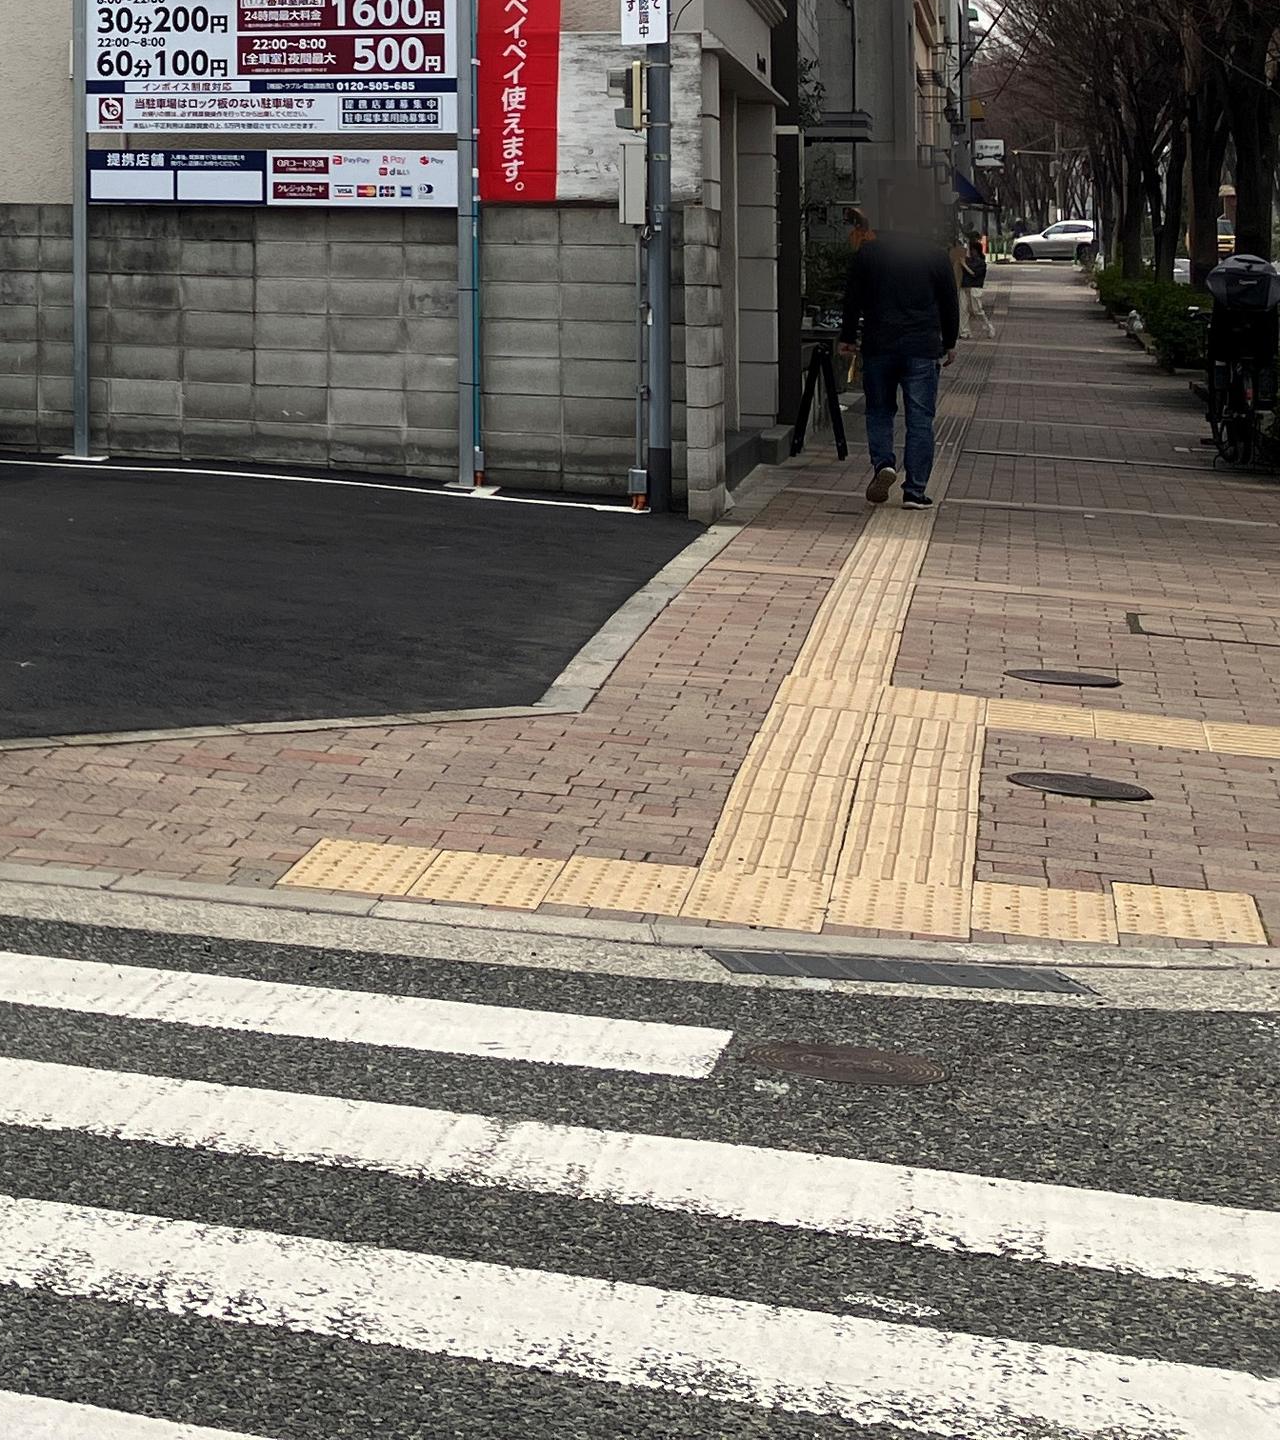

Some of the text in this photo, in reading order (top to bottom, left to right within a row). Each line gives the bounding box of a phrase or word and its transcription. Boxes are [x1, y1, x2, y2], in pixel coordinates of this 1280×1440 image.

[244, 9, 323, 22] 24時間最大料金
[352, 37, 441, 72] 500円
[142, 82, 233, 92] インボイス制度対応
[336, 81, 416, 92] 0120-505-685
[134, 97, 316, 110] 当駐車場はロック板のない駐車場です
[106, 152, 165, 167] 提携店舗
[343, 156, 370, 165] PayPay
[277, 184, 326, 194] クレジットカード
